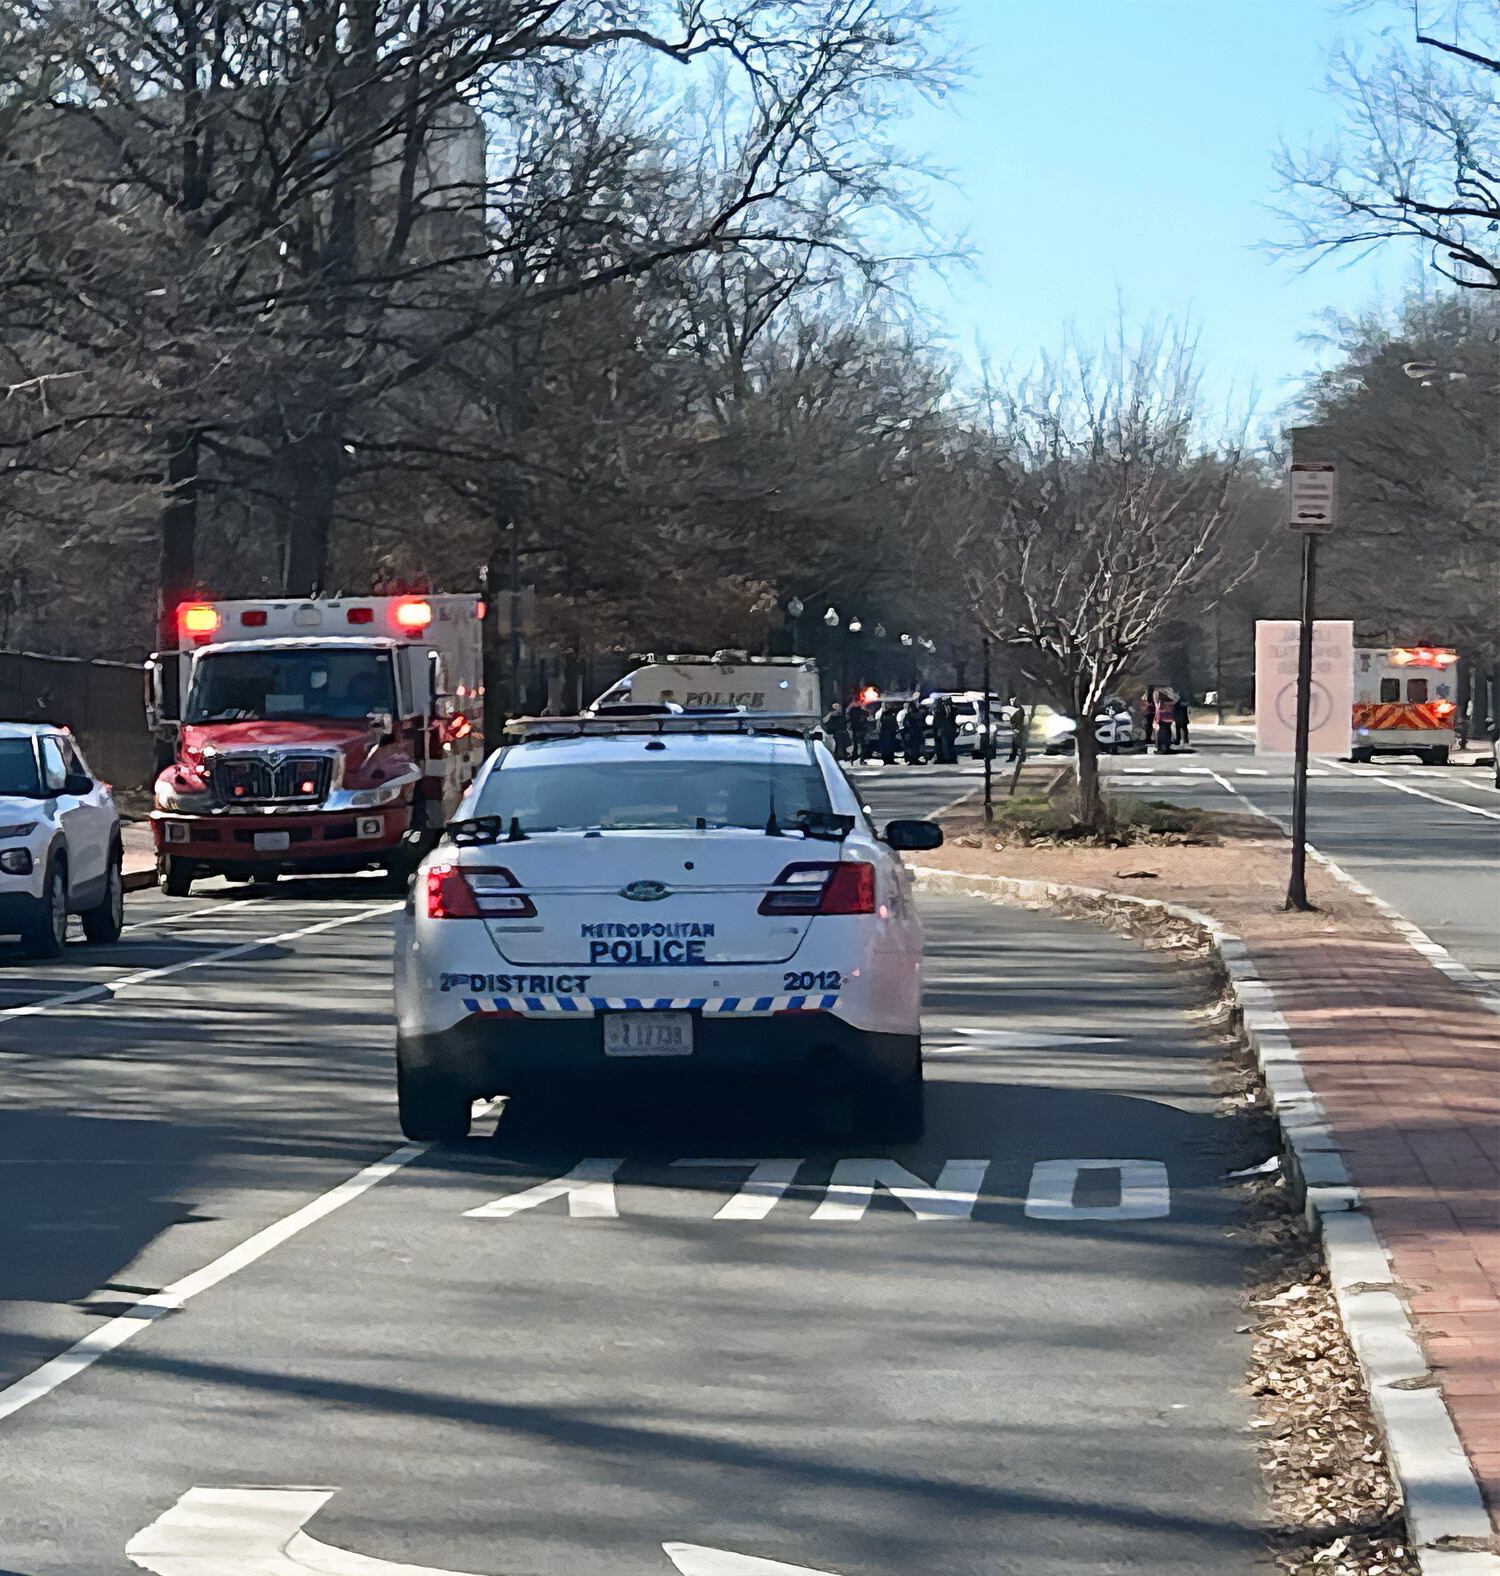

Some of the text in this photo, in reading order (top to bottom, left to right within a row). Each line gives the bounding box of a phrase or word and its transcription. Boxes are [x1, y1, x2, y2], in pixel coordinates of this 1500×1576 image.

[686, 691, 766, 708] POLICE
[580, 923, 715, 938] METROPOLITAN
[589, 940, 706, 964] POLICE
[470, 973, 592, 993] DISTRICT
[783, 971, 842, 991] 2012
[460, 1157, 1171, 1220] ONLY
